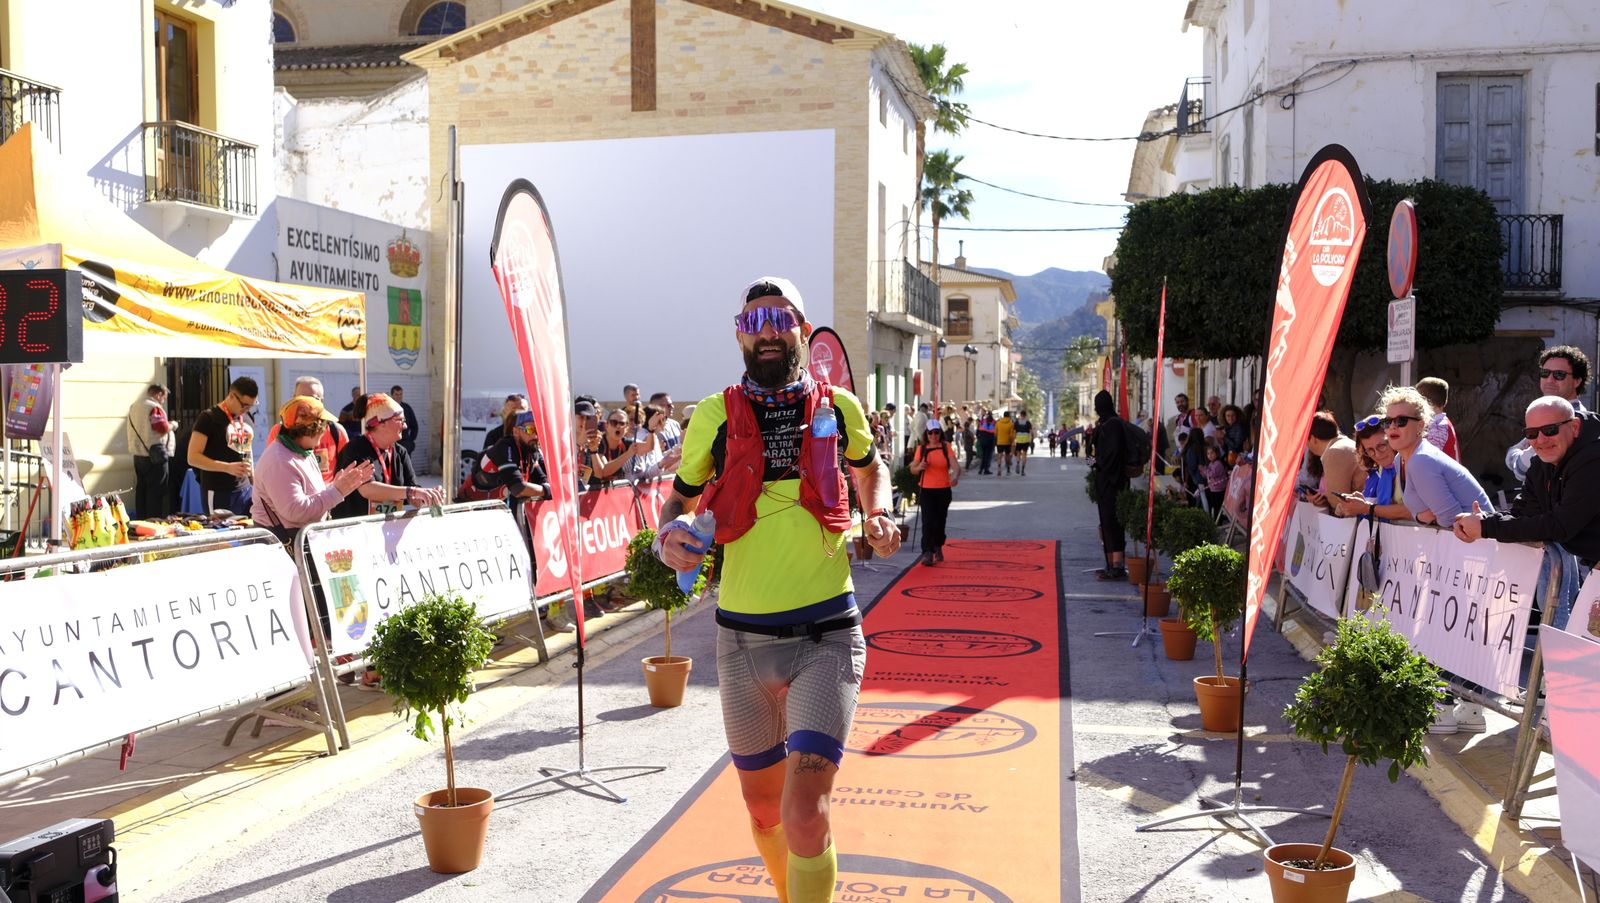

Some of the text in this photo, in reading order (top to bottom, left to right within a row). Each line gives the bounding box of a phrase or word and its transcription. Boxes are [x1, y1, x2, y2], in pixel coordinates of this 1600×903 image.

[287, 227, 380, 263] EXCELENTÍSIMO
[290, 260, 379, 292] AYUNTAMIENTO
[769, 440, 793, 449] ULTRA
[770, 458, 792, 468] 2022
[247, 580, 275, 603] DE
[375, 553, 522, 610] CANTORIA
[1493, 580, 1519, 604] DE
[1380, 579, 1515, 654] CANTORIA
[0, 608, 290, 716] CANTORIA
[836, 787, 972, 800] de Canto
[925, 887, 976, 902] LA
